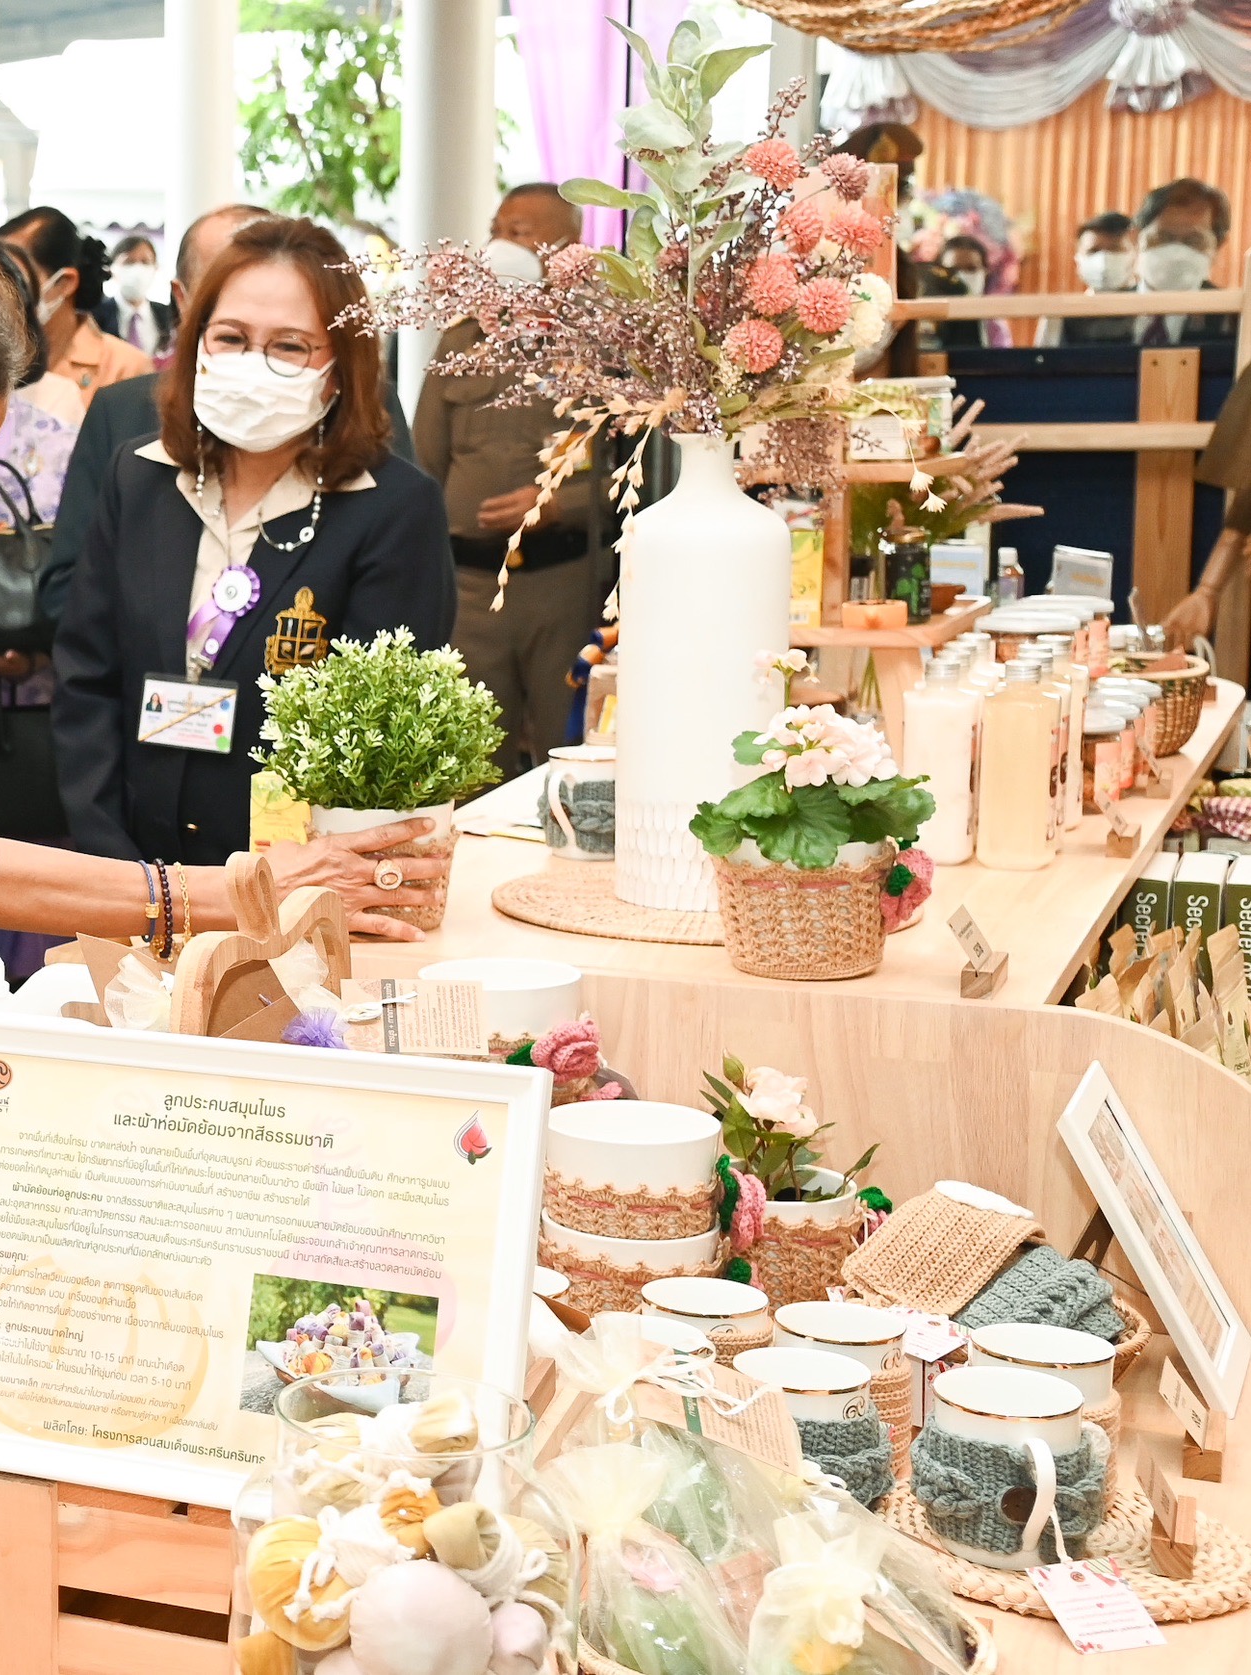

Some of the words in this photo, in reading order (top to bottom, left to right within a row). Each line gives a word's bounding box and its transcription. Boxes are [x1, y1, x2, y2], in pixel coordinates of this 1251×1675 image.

[163, 1094, 286, 1119] ลูกประคบสมุนไพร
[113, 1112, 334, 1149] และผ้าห่อมัดย้อมจากสีธรรมชาติ
[12, 1181, 103, 1202] ผ้ามัดย้อมห่อลูกประคบ
[215, 1186, 261, 1201] สร้างอาชีพ
[262, 1192, 311, 1206] สร้างรายได้
[138, 1214, 223, 1234] ศิลปะและการออกแบบ
[67, 1290, 137, 1310] เกร็งของกล้ามเนื้อ
[4, 1321, 84, 1343] ลูกประคบขนาดใหญ่
[90, 1350, 115, 1363] 10-15
[117, 1355, 134, 1365] นาที
[129, 1374, 149, 1384] เวลา
[150, 1375, 173, 1388] 5-10
[43, 1419, 88, 1436] ผลิตโดย:
